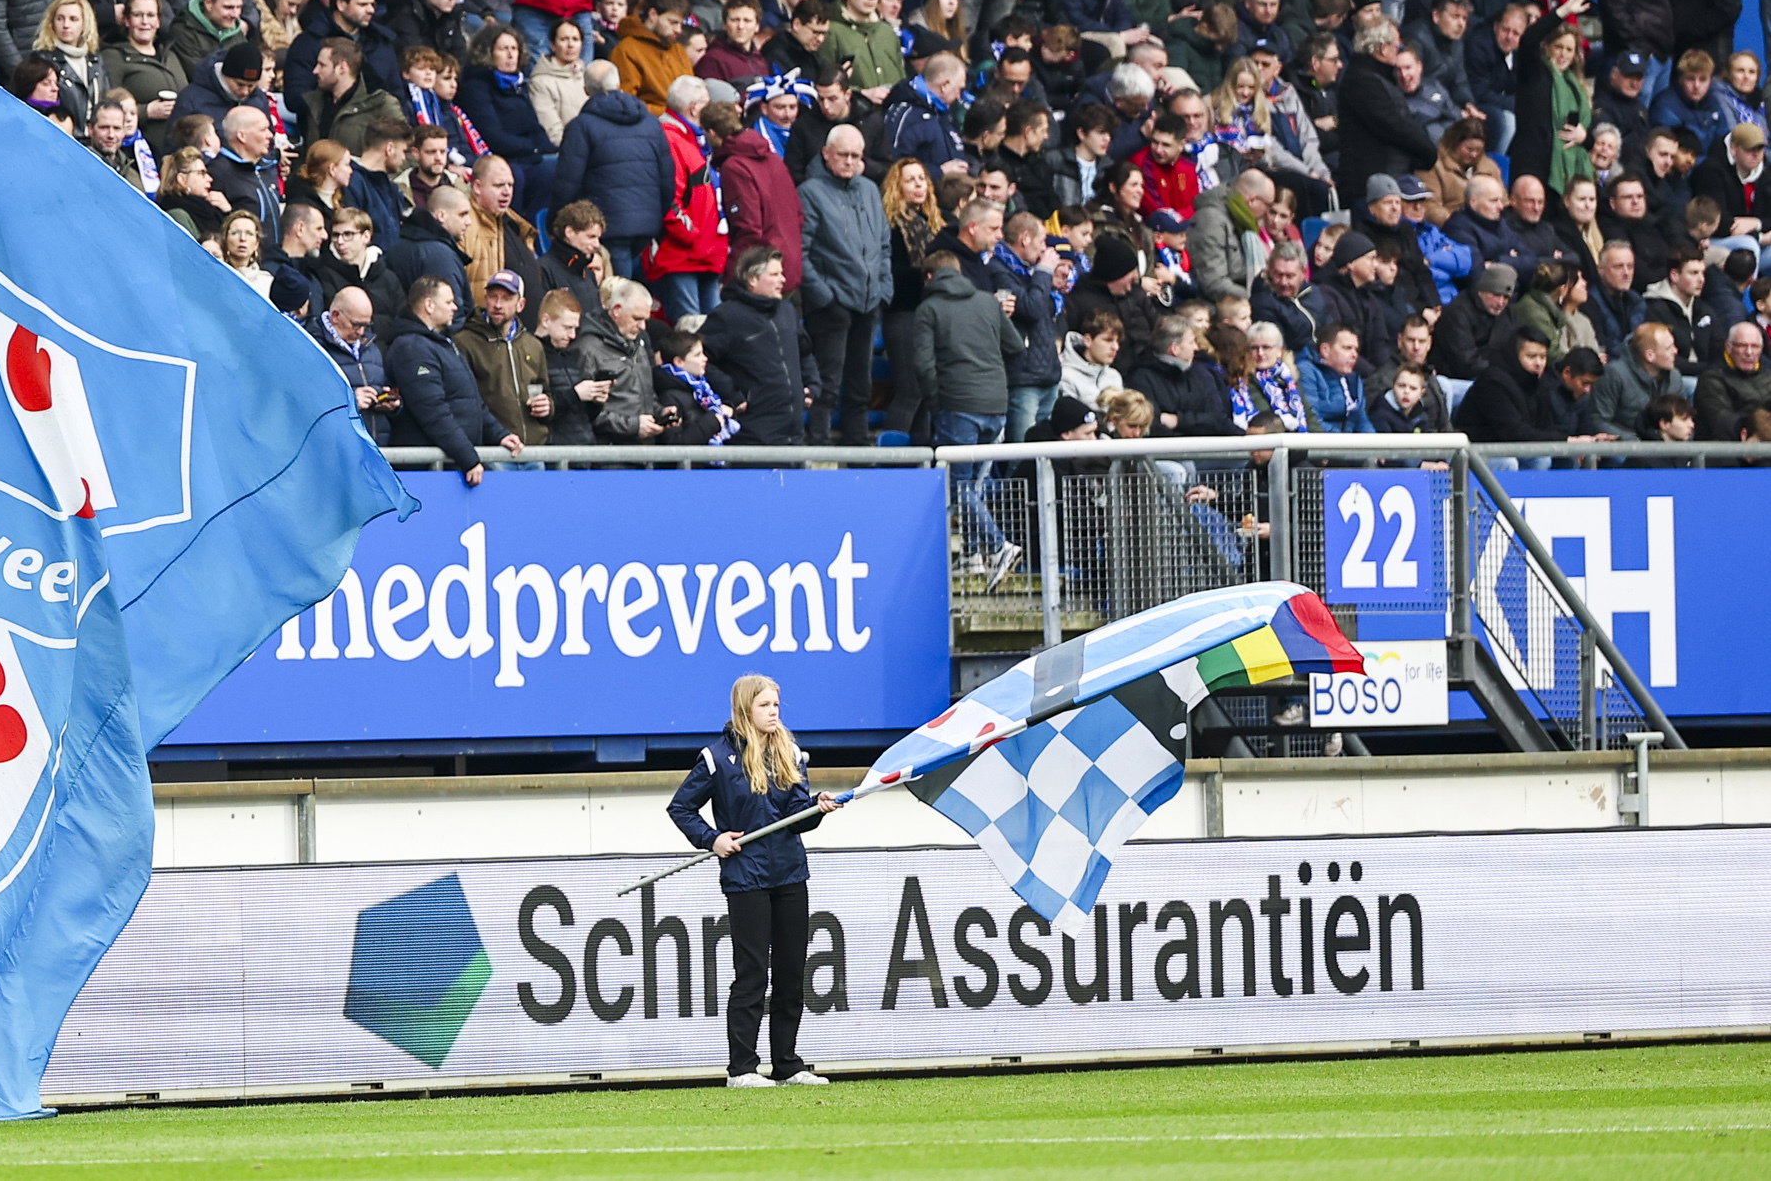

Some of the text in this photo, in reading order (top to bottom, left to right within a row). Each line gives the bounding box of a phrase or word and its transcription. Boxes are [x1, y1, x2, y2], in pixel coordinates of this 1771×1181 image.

[275, 520, 871, 689] medprevent
[1337, 481, 1419, 589] 22
[517, 860, 1424, 1026] Schra Assurantiën
